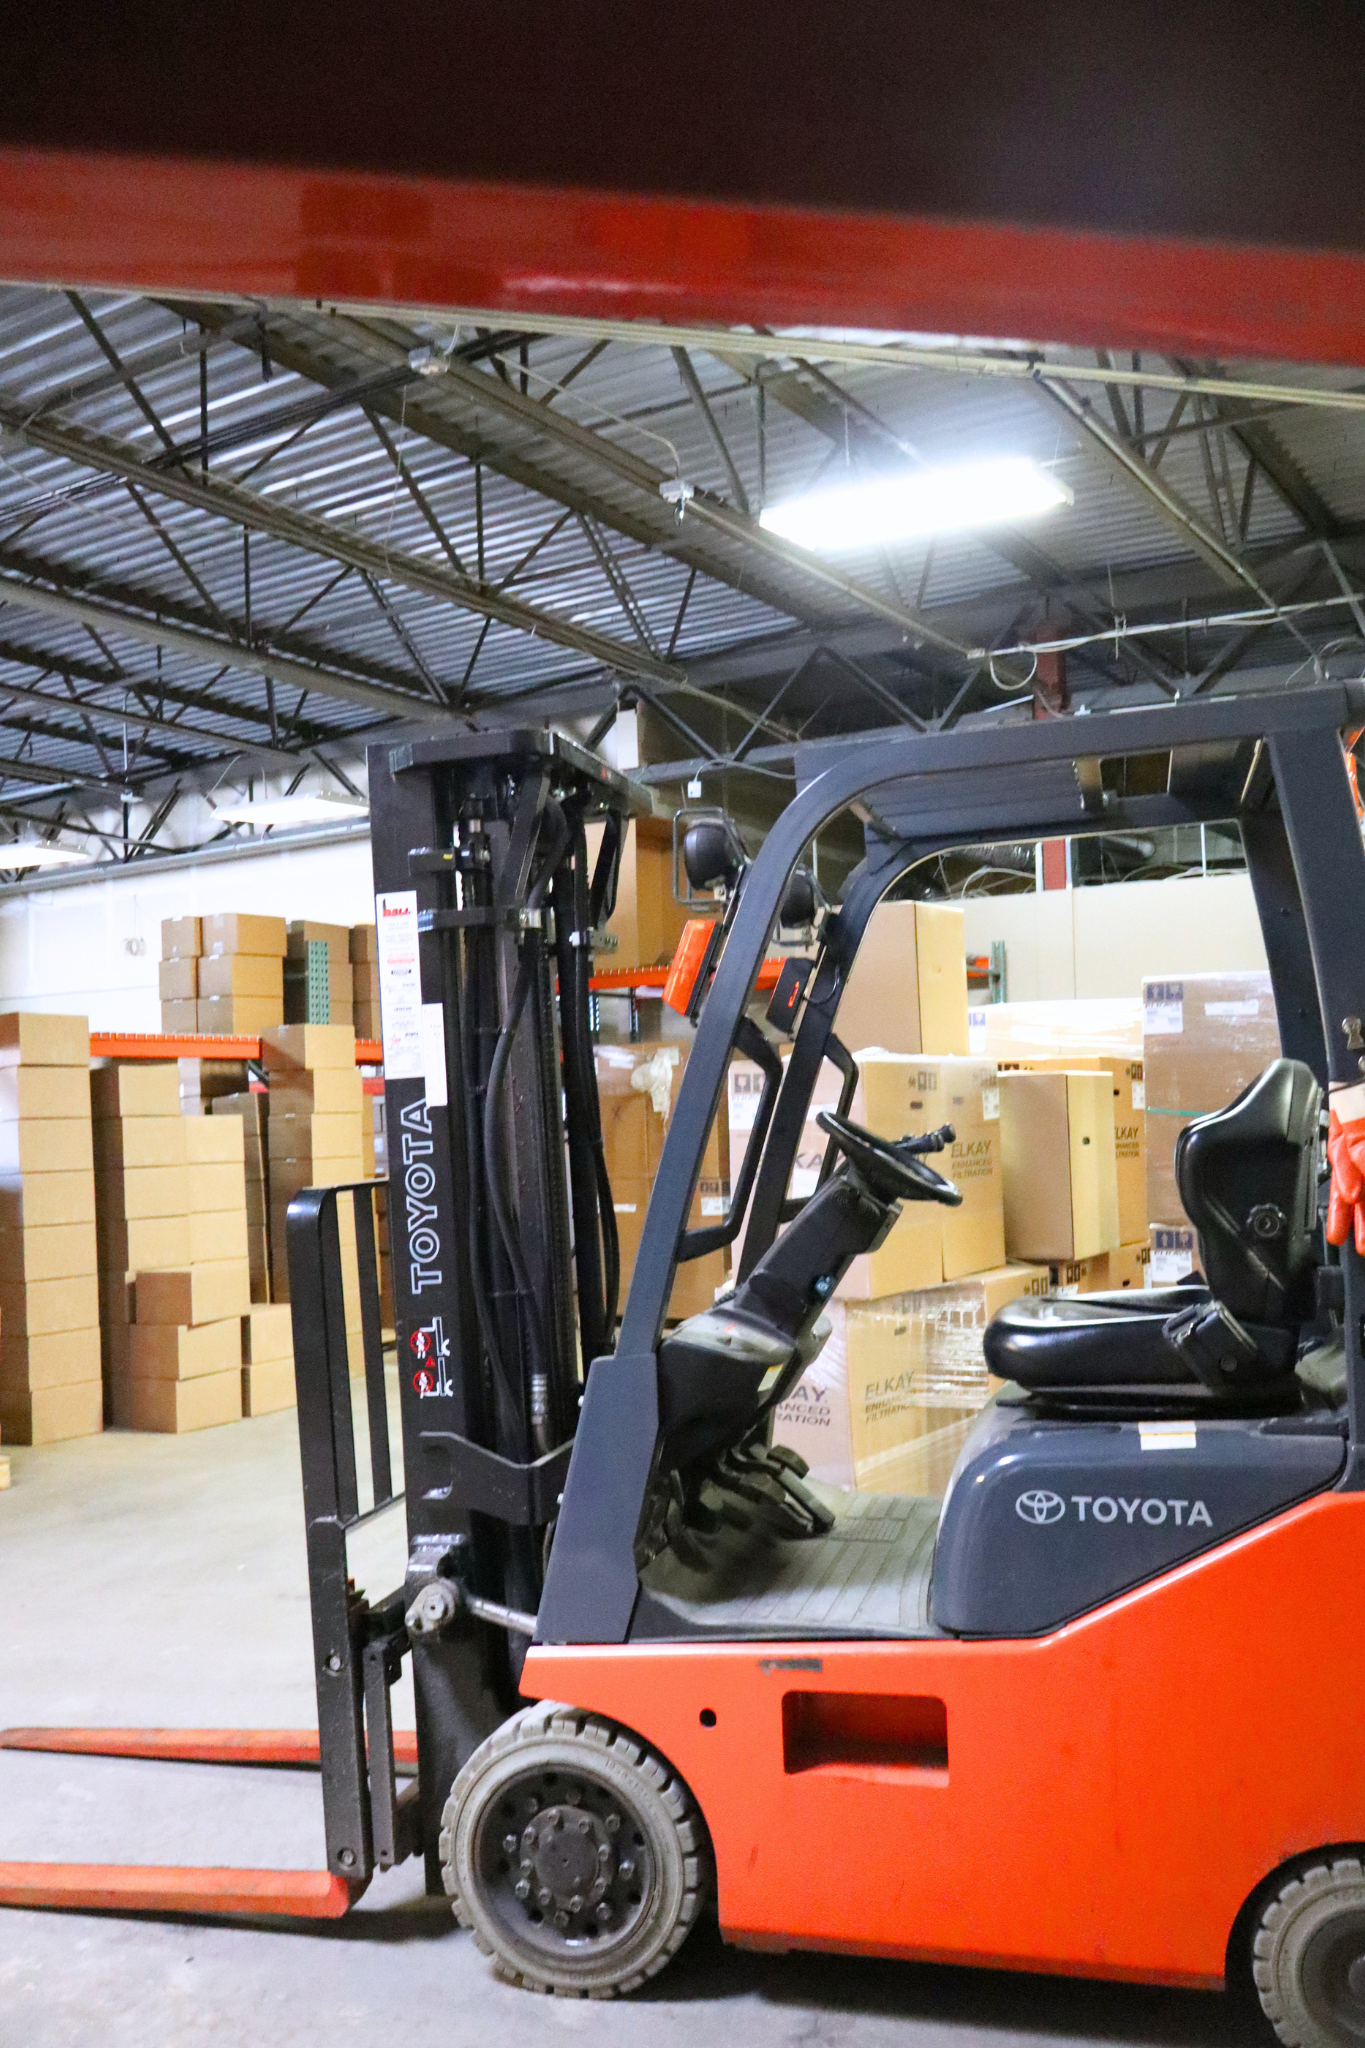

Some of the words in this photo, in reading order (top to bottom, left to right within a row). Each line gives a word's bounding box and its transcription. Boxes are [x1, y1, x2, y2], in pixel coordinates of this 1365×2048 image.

[951, 1139, 992, 1159] ELKAY
[400, 1097, 442, 1295] TOYOTA
[865, 1370, 915, 1399] ELKAY
[1071, 1495, 1214, 1527] TOYOTA
